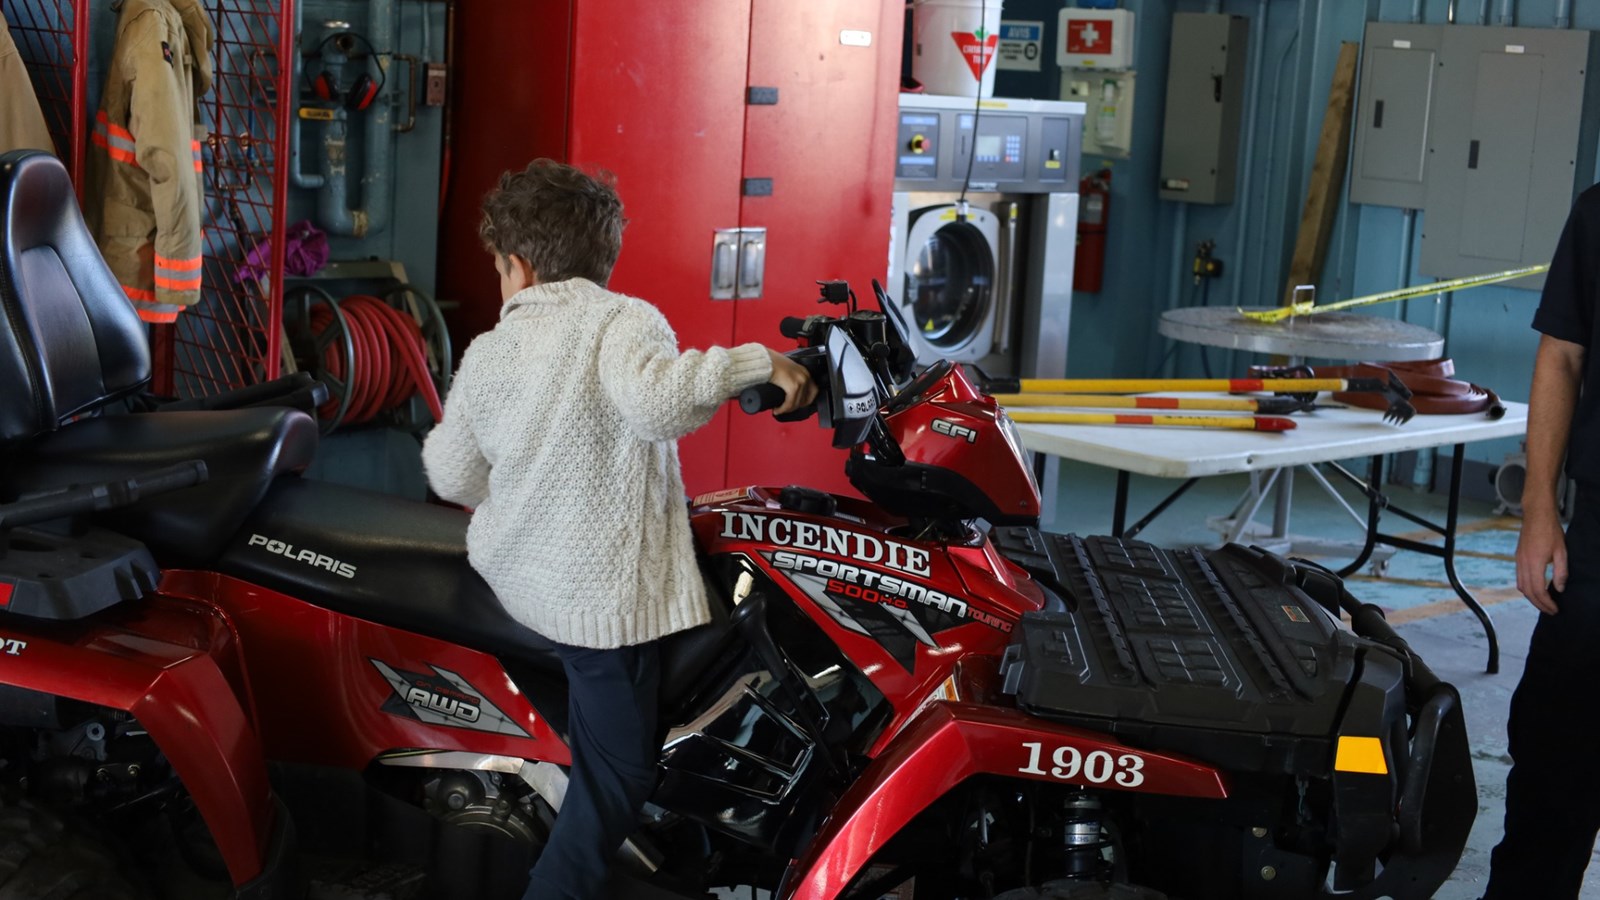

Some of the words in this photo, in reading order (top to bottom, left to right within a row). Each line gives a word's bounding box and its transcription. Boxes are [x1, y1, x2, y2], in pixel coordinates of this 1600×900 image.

[1008, 26, 1031, 38] AVIS
[932, 419, 977, 443] EFI
[248, 533, 357, 579] POLARIS
[720, 511, 931, 578] INCENDIE
[772, 551, 967, 618] SPORTSMAN
[966, 607, 1013, 633] TOURING
[407, 687, 480, 722] AWD
[1018, 742, 1145, 788] 1903
